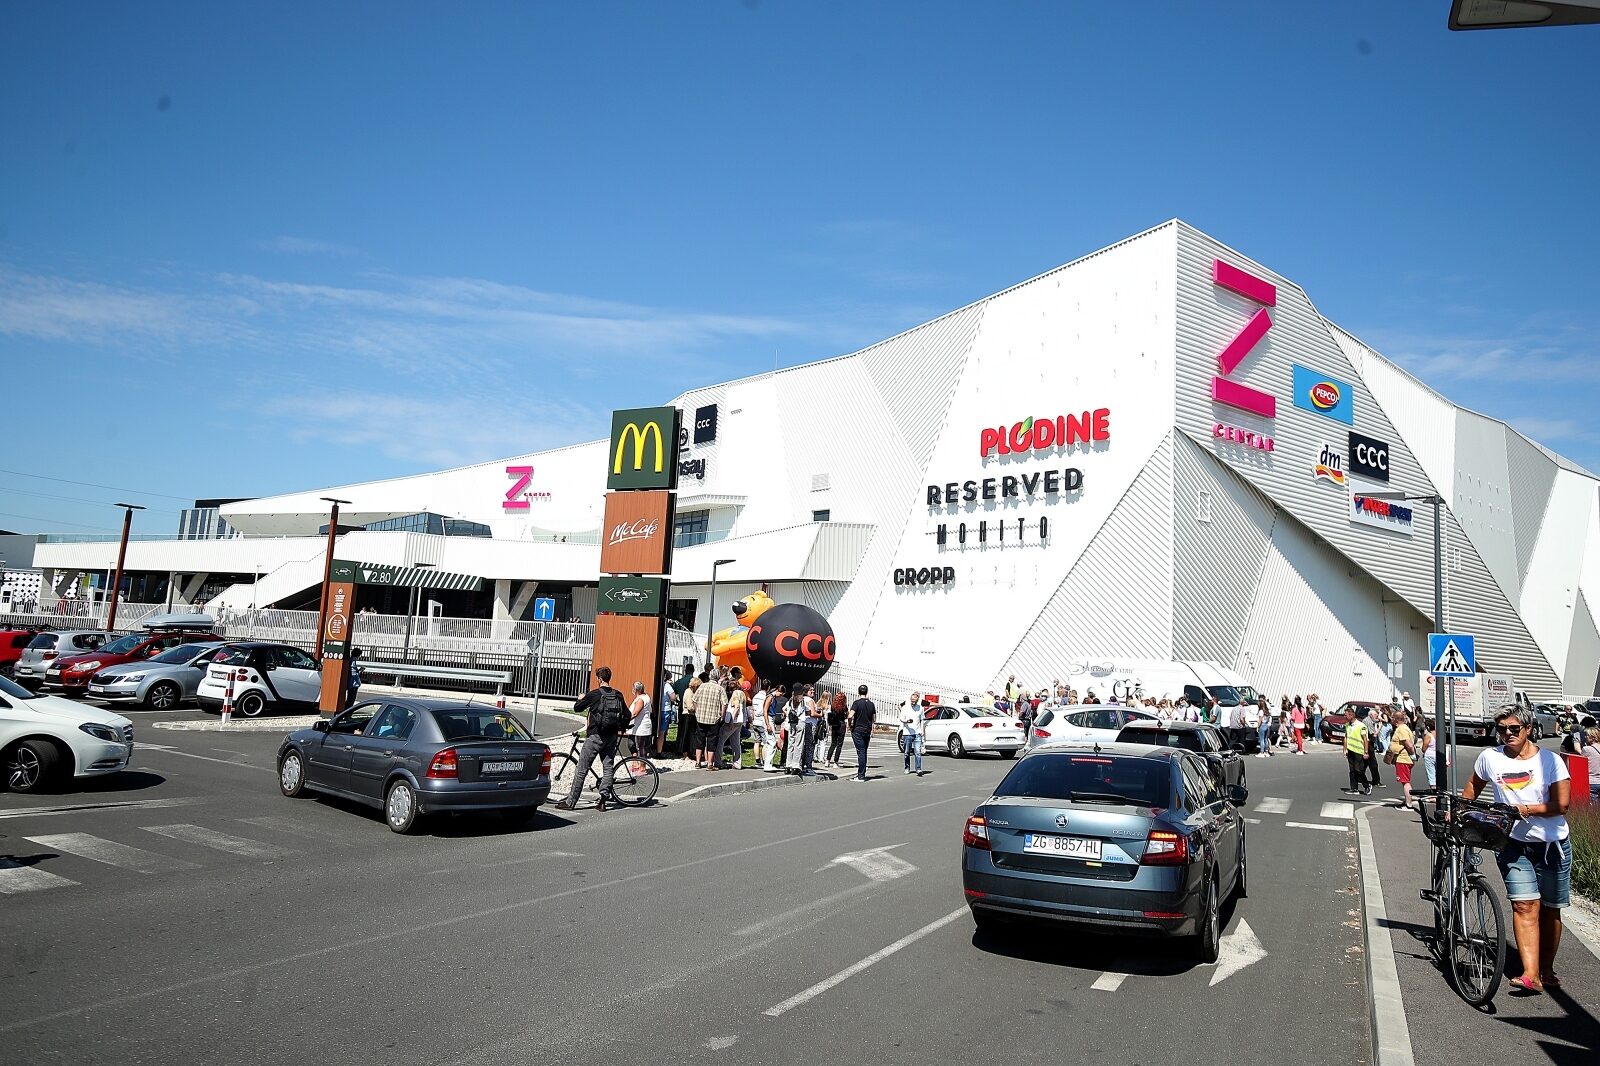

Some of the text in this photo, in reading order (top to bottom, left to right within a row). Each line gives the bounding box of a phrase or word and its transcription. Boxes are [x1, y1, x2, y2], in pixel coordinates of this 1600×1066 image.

[1316, 387, 1337, 401] PEPCO
[697, 419, 711, 429] CCC
[981, 408, 1110, 457] PLODINE
[1212, 423, 1275, 452] CENTAR
[1320, 444, 1341, 470] dm
[1356, 443, 1387, 470] CCC
[927, 467, 1083, 505] RESERVED
[936, 516, 1048, 545] MOHITO
[371, 571, 391, 583] 2.80
[893, 566, 956, 587] CROPP
[1033, 834, 1047, 849] ZG
